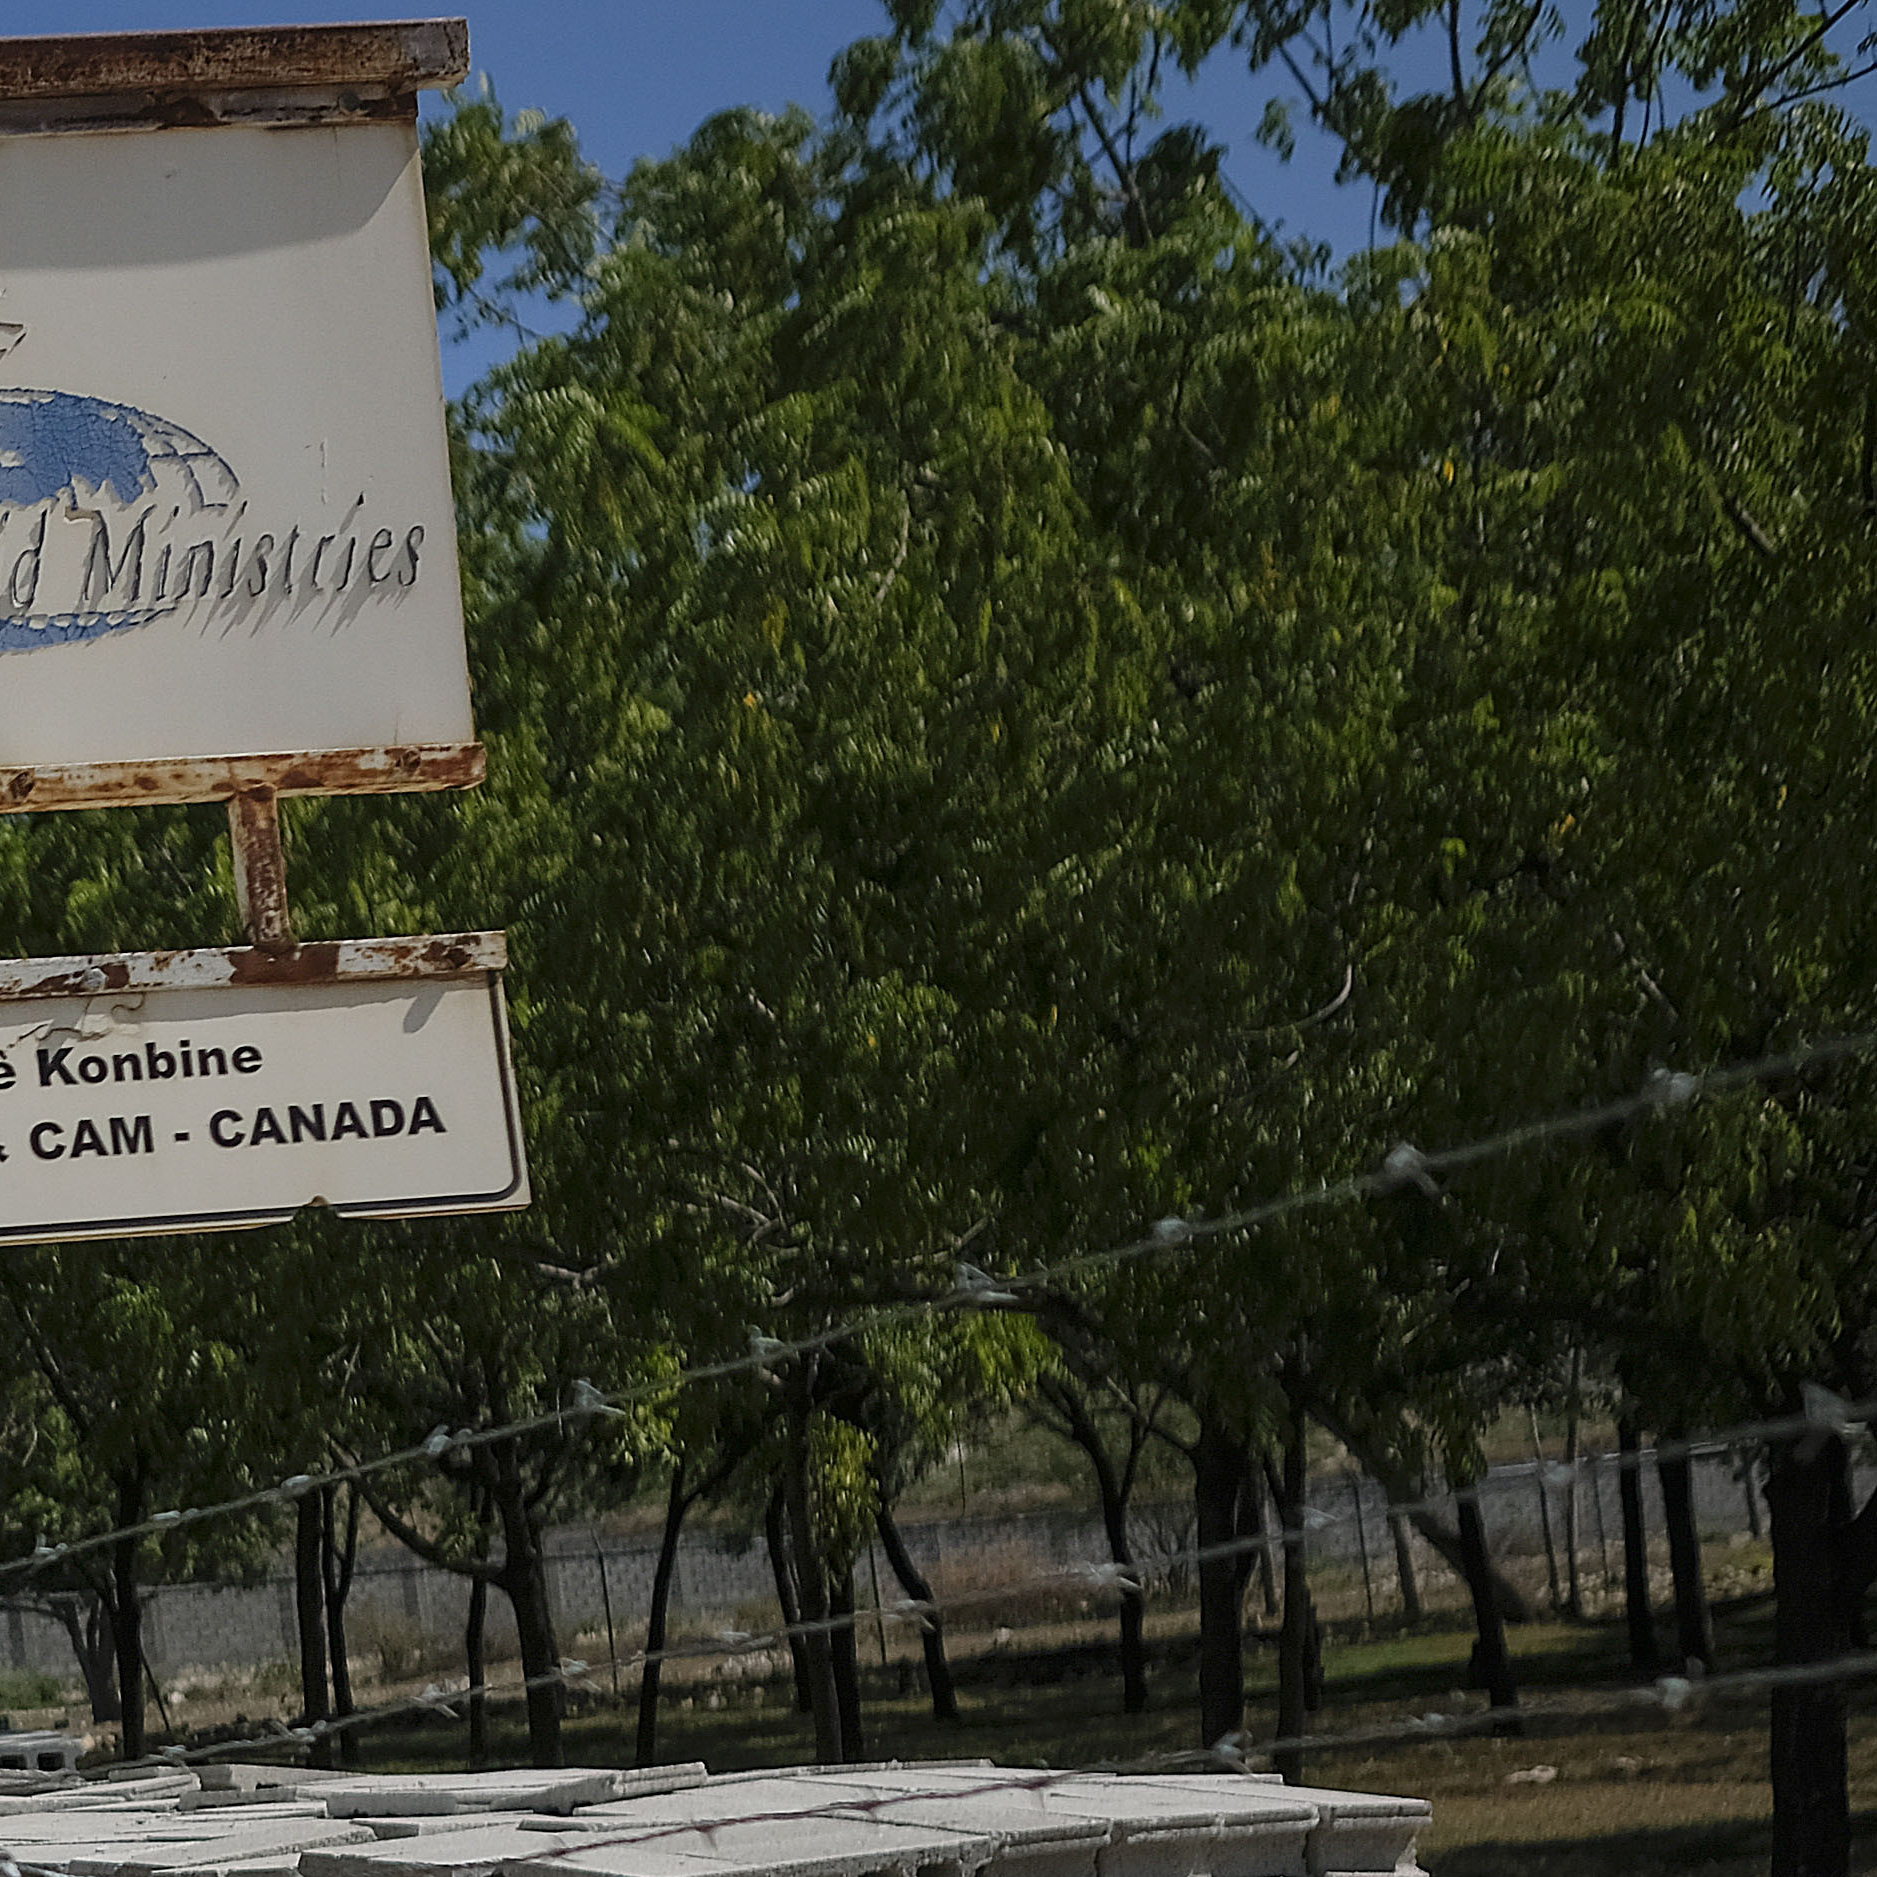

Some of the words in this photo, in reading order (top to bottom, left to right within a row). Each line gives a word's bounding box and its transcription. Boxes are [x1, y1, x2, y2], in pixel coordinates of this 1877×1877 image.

[78, 494, 426, 602] Ministries
[36, 1039, 263, 1087] Konbine
[29, 1116, 154, 1161] CAM
[174, 1131, 191, 1142] -
[209, 1096, 447, 1148] CANADA
